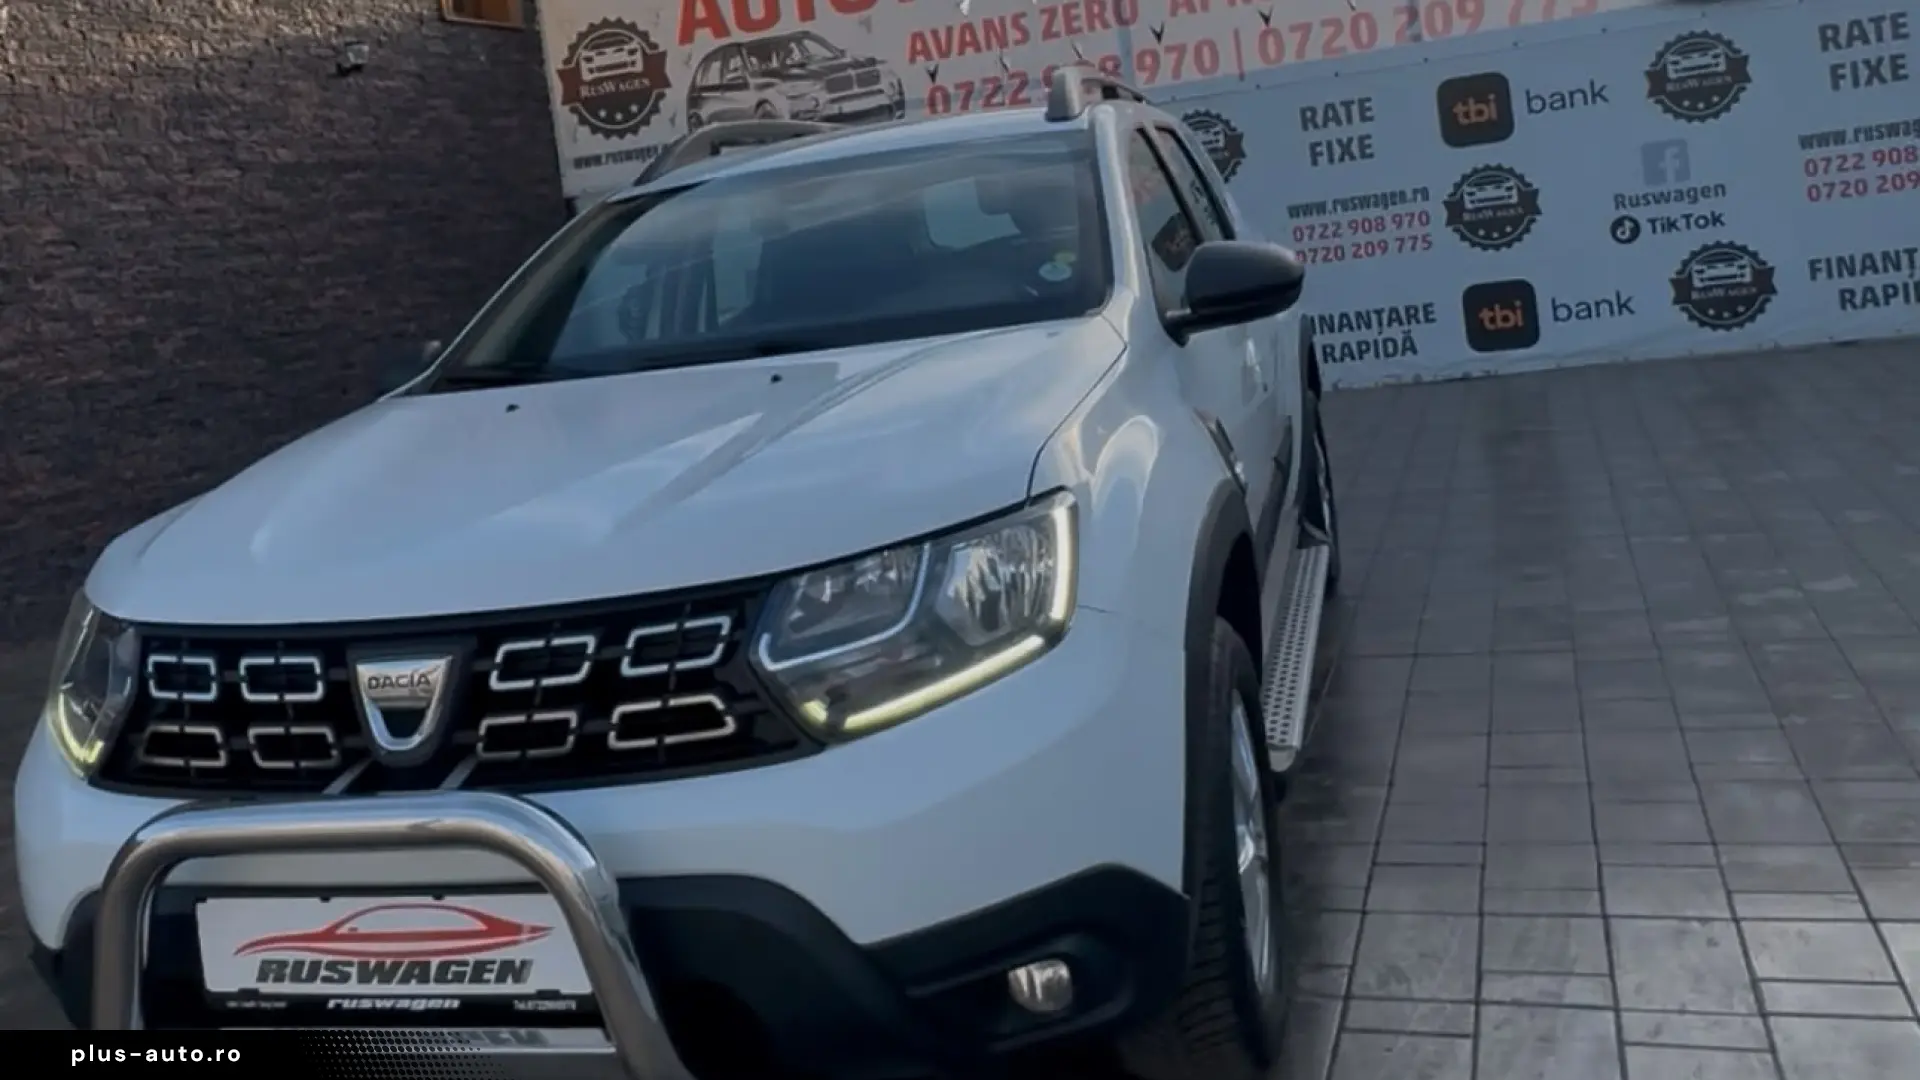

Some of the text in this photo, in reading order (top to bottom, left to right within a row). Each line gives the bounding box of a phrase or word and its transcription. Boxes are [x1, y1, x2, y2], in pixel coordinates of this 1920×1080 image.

[907, 0, 1138, 64] AVANS ZERO
[1818, 11, 1910, 52] RATE
[926, 70, 1031, 115] 0722
[1136, 39, 1219, 86] 970
[1257, 12, 1378, 66] 0720
[1393, 0, 1485, 46] 209
[1829, 54, 1910, 92] FIXE
[1299, 97, 1374, 132] RATE
[1453, 79, 1609, 126] tbi bank
[1308, 134, 1375, 167] FIXE
[1804, 144, 1919, 178] 0722 908
[1613, 183, 1727, 211] Ruswagen
[1806, 170, 1920, 203] 0720 209
[1292, 209, 1431, 243] 0722 908 970
[1646, 210, 1726, 236] TikTok
[1295, 232, 1433, 264] 0720 209 775
[1308, 302, 1437, 336] INANȚARE
[1479, 289, 1636, 331] tbi bank
[1321, 328, 1419, 364] RAPIDĂ
[368, 671, 431, 690] DACIA
[256, 959, 533, 985] RUSWAGEN
[327, 998, 460, 1012] ruswagen
